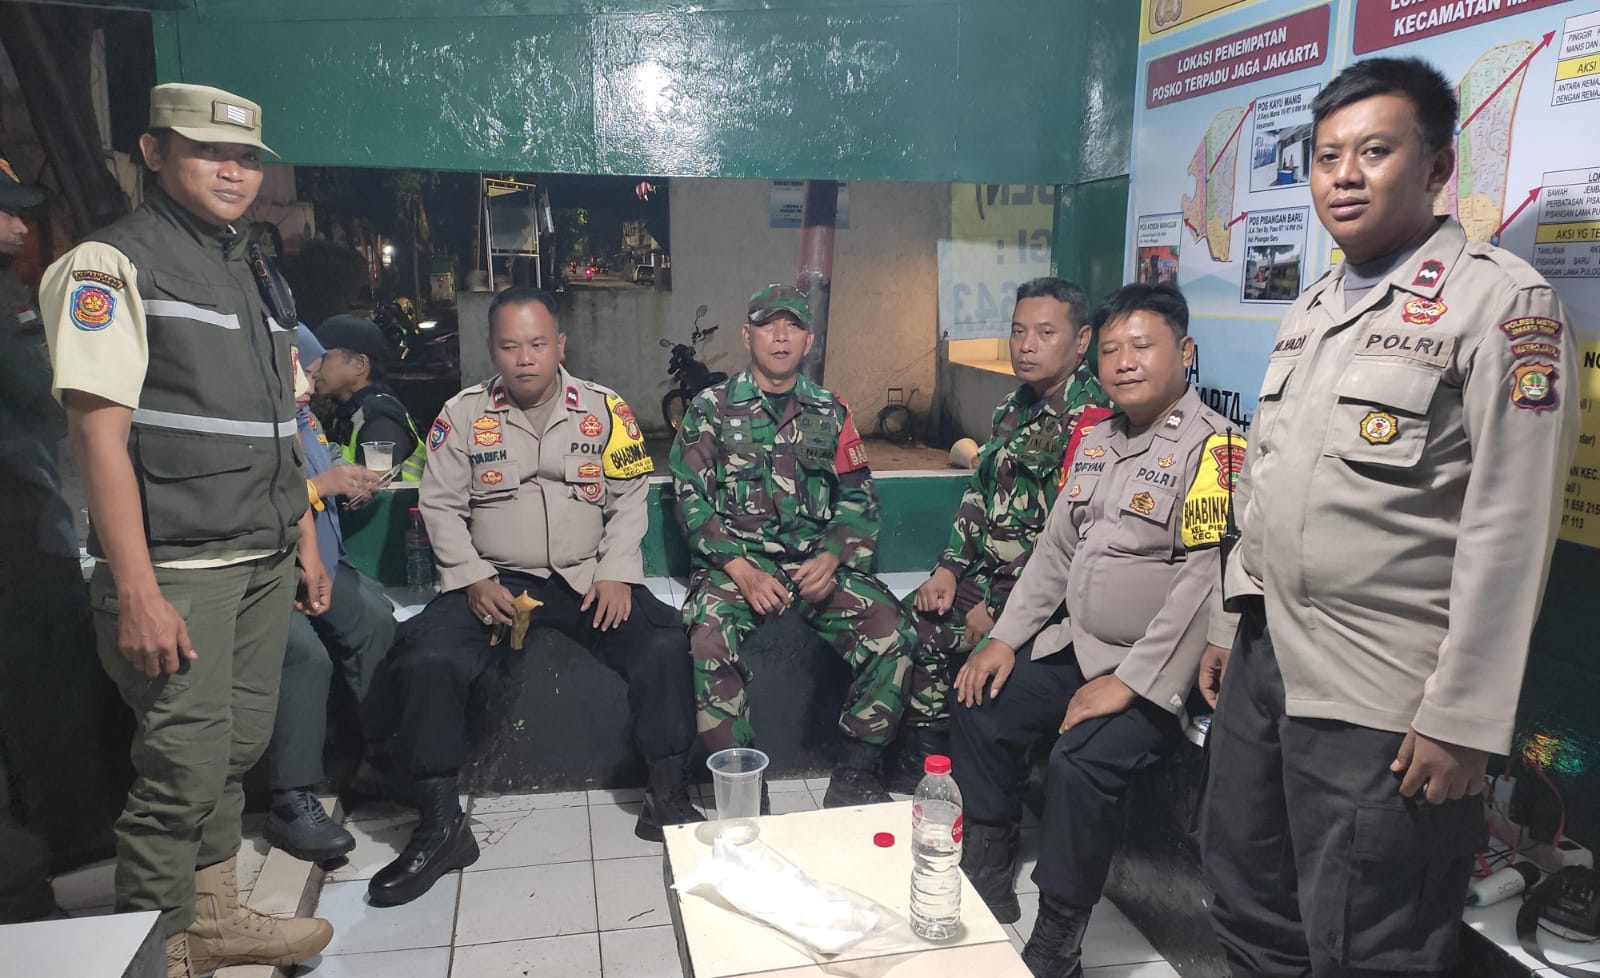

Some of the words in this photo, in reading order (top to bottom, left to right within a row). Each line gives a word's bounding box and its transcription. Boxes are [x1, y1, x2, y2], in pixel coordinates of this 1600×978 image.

[1393, 0, 1501, 37] KECAMATAN
[1568, 31, 1592, 42] PINGGIR
[1177, 52, 1213, 75] LOKASI
[1215, 26, 1287, 63] PENEMPATAN
[1566, 43, 1584, 53] MANIS
[1585, 40, 1598, 50] DAN
[1152, 80, 1182, 102] POSKO
[1184, 68, 1229, 93] TERPADU
[1231, 59, 1260, 80] JAGA
[1262, 42, 1319, 71] JAKARTA
[1577, 61, 1597, 74] AKSI
[1557, 81, 1580, 92] ANTARA
[1257, 101, 1269, 111] POS
[1284, 94, 1302, 106] MANIS
[1556, 93, 1580, 103] DENGAN
[1547, 188, 1569, 198] BAWAH
[1546, 197, 1584, 208] PERBATASAN
[1249, 216, 1260, 226] POS
[1260, 213, 1287, 225] PISANGAN
[1287, 212, 1304, 223] BARU
[1545, 209, 1575, 218] PISANGAN
[1575, 209, 1591, 218] LAMA
[1556, 229, 1575, 240] AKSI
[1577, 228, 1588, 239] YG
[1538, 247, 1566, 255] TAWURAN
[1573, 256, 1590, 265] BARU
[1563, 267, 1579, 276] LAMA
[1365, 334, 1444, 357] POLRI
[1136, 467, 1178, 488] POLRI
[1580, 466, 1600, 480] KEC.
[1191, 525, 1206, 535] KEL.
[1192, 531, 1215, 542] KEC.
